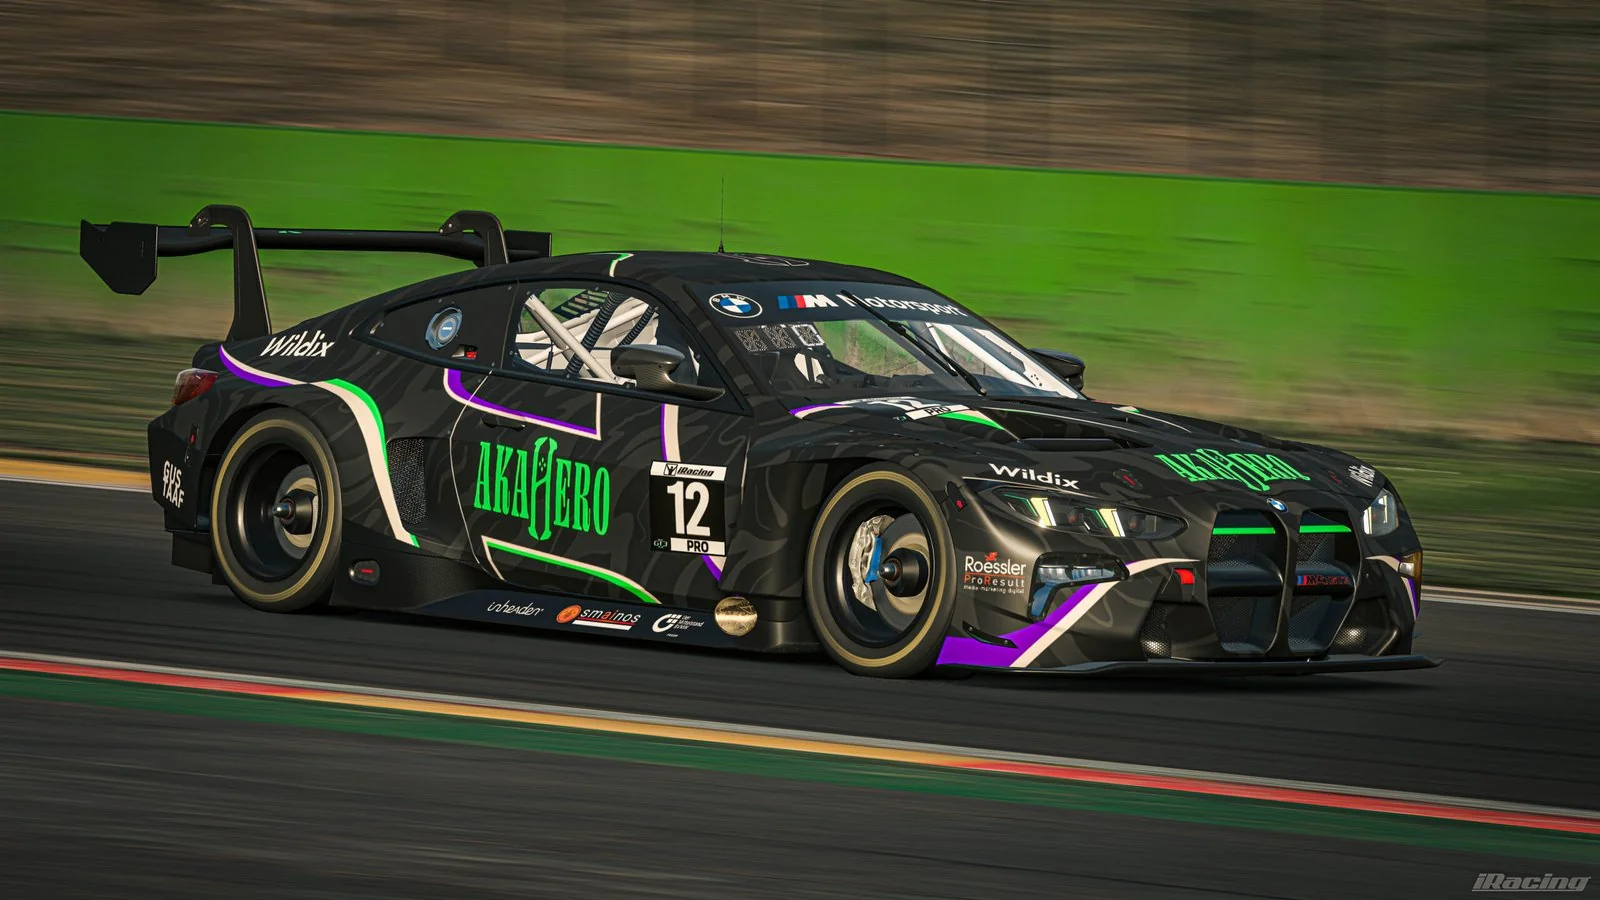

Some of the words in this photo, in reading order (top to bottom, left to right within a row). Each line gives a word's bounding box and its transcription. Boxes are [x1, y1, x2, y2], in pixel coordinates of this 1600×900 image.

[259, 330, 335, 357] Wildix
[163, 460, 182, 490] GUS
[677, 466, 715, 477] iRacing
[989, 462, 1080, 490] Wildix
[162, 476, 185, 509] TAAF
[473, 436, 610, 541] AKAHERO
[666, 480, 711, 537] 12
[686, 539, 710, 553] PRO
[964, 555, 1027, 576] Roessler
[963, 574, 1025, 588] ProResult
[580, 608, 642, 623] smainos
